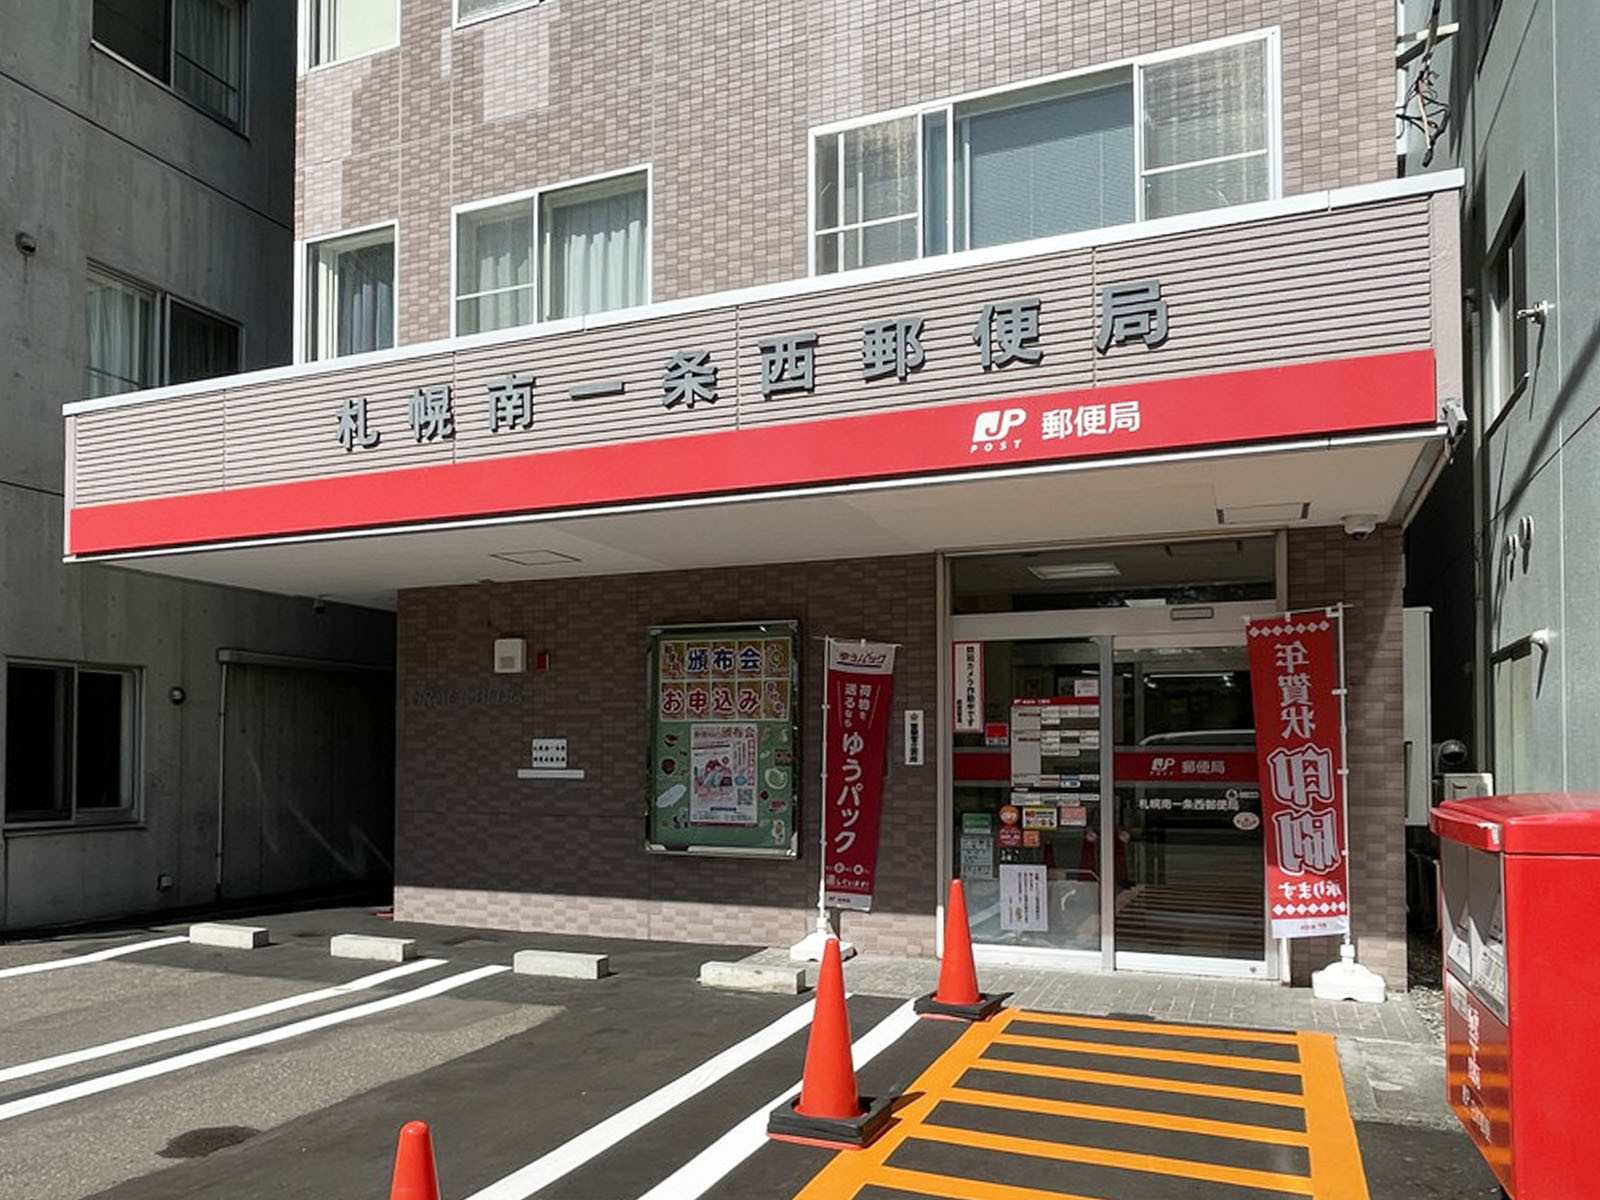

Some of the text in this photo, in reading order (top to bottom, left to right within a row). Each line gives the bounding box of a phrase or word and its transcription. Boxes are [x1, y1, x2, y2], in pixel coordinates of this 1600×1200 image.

[335, 278, 1169, 451] 札幌南一条西郵便局
[972, 401, 1140, 442] JP 郵便局
[970, 439, 1023, 454] POST
[687, 646, 762, 673] 頒布会
[839, 650, 887, 664] ゆうパック
[662, 688, 760, 714] お申込み
[834, 731, 864, 853] ゆうパック
